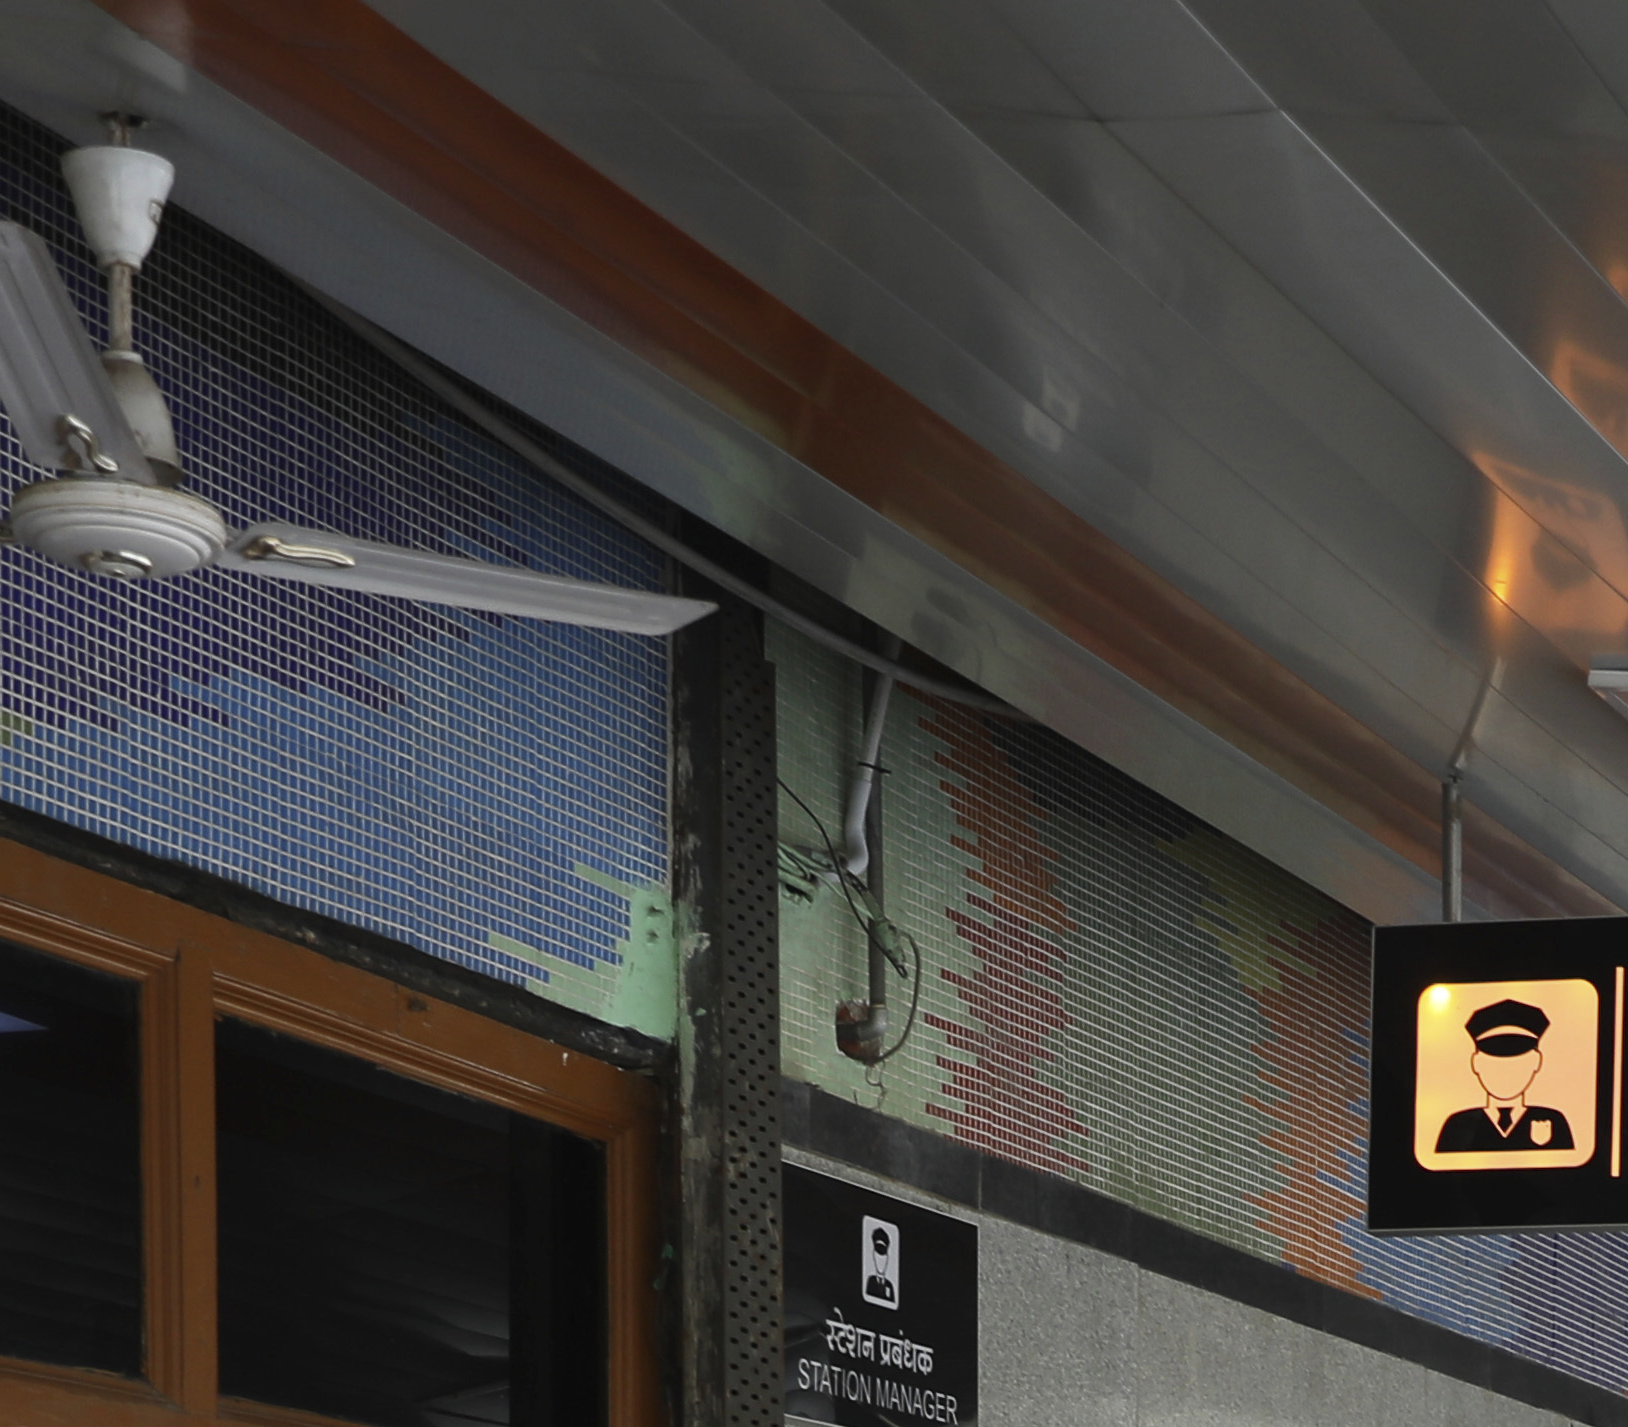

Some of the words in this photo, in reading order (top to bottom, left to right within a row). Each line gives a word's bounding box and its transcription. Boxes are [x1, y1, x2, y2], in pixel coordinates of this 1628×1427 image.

[825, 1307, 876, 1362] स्टेशन
[879, 1329, 934, 1376] प्रबंधक
[797, 1358, 872, 1404] STATION
[876, 1377, 959, 1426] MANAGER
